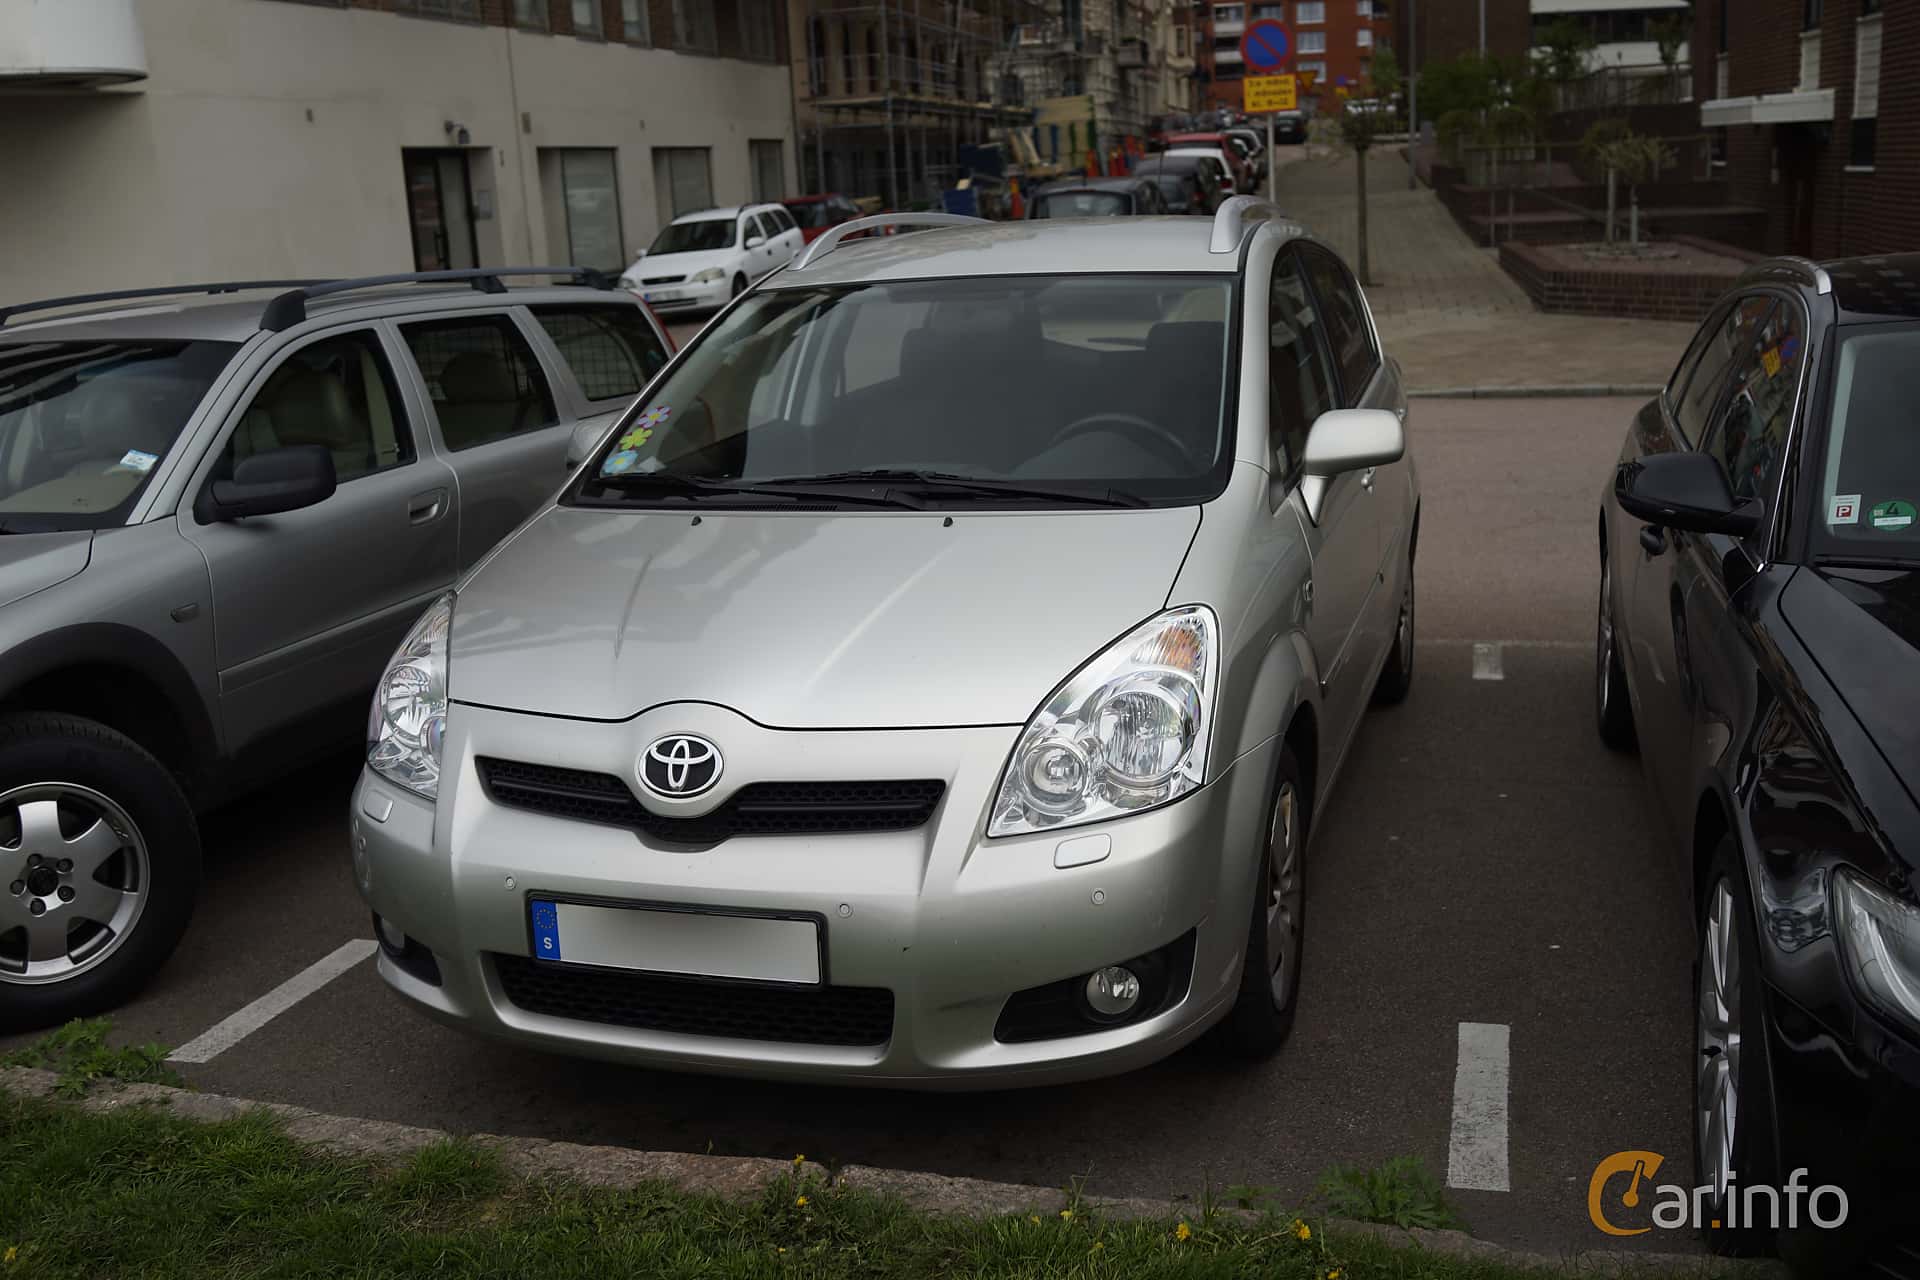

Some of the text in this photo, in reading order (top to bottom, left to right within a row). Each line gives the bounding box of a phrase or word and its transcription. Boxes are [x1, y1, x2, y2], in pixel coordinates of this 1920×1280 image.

[1839, 506, 1850, 517] P
[1886, 503, 1898, 514] 4
[543, 937, 552, 950] S
